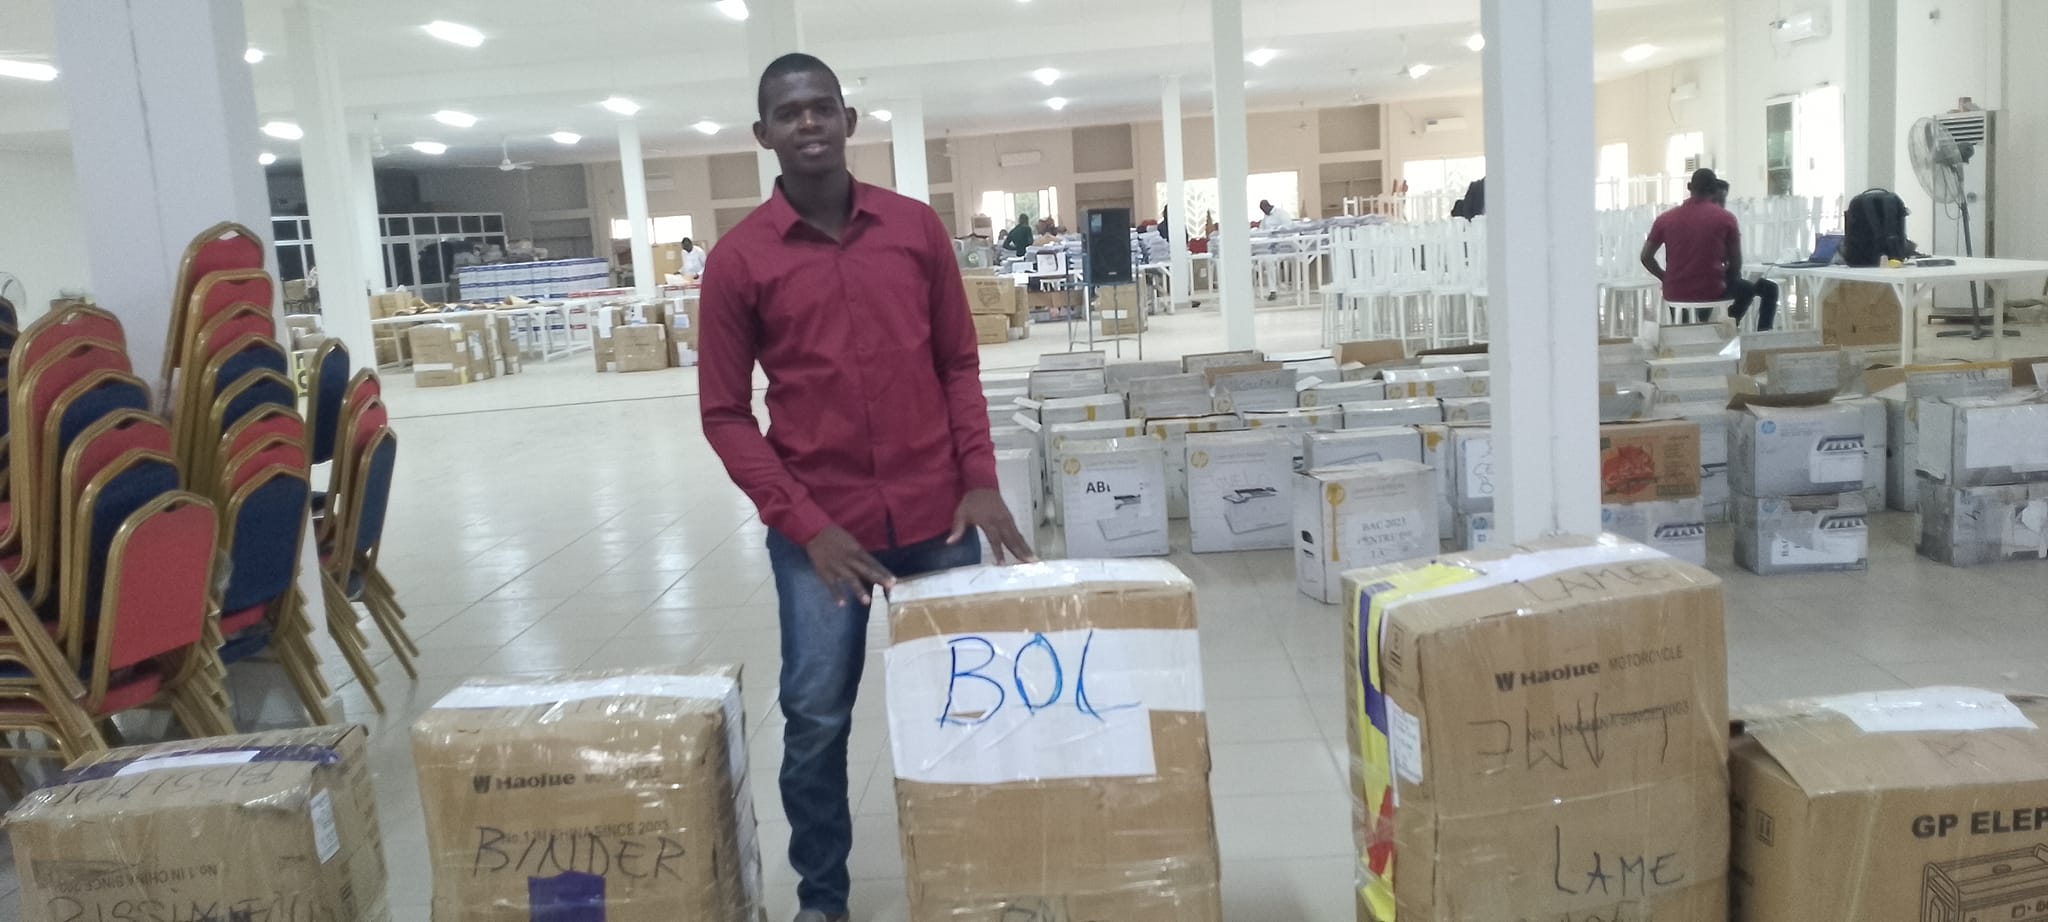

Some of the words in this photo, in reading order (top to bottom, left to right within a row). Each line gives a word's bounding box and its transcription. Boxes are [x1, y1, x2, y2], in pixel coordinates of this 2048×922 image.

[936, 629, 1142, 728] BOL
[1607, 645, 1684, 672] MOTORCYCLE
[1467, 692, 1669, 771] LAME
[472, 826, 686, 882] BINDER
[1911, 813, 1959, 839] GP
[1553, 824, 1685, 897] LAME
